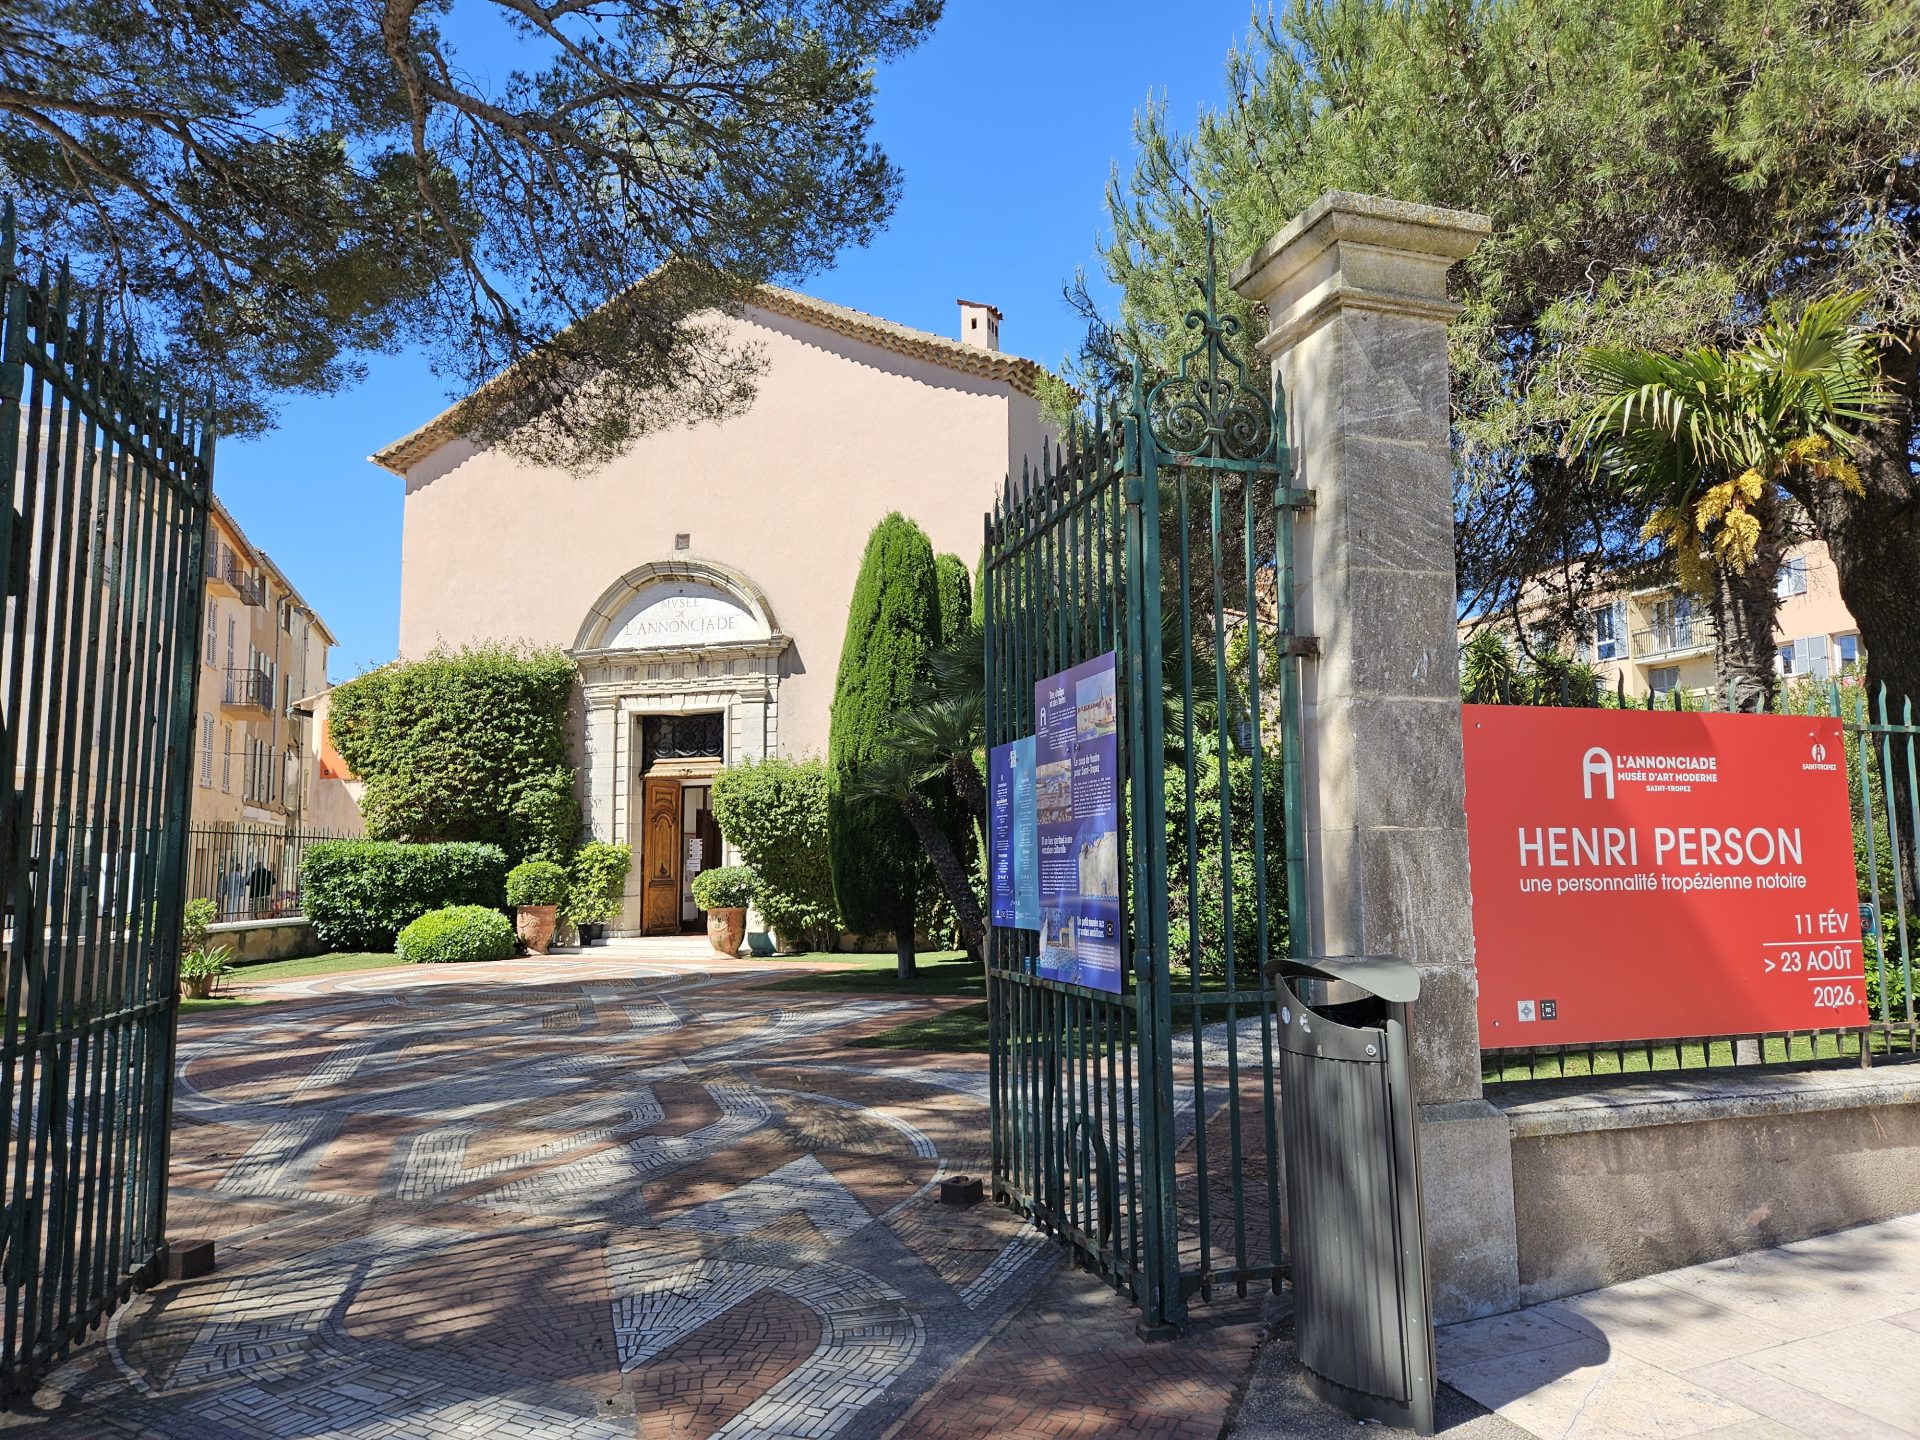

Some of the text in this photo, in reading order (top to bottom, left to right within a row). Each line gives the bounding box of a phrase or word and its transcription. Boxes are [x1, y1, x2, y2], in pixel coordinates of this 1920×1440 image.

[1616, 755, 1717, 770] L'ANNONCIADE
[1617, 770, 1718, 783] MUSÉE D'ART MODERNE
[1645, 785, 1692, 793] SAINT-TROPEZ
[1518, 827, 1803, 867] HENRI PERSON
[1520, 872, 1807, 895] une personnalité tropézienne notoire
[1794, 908, 1849, 934] 11 FÉV
[1781, 945, 1852, 973] 23 AOÛT
[1813, 985, 1855, 1007] 2026
